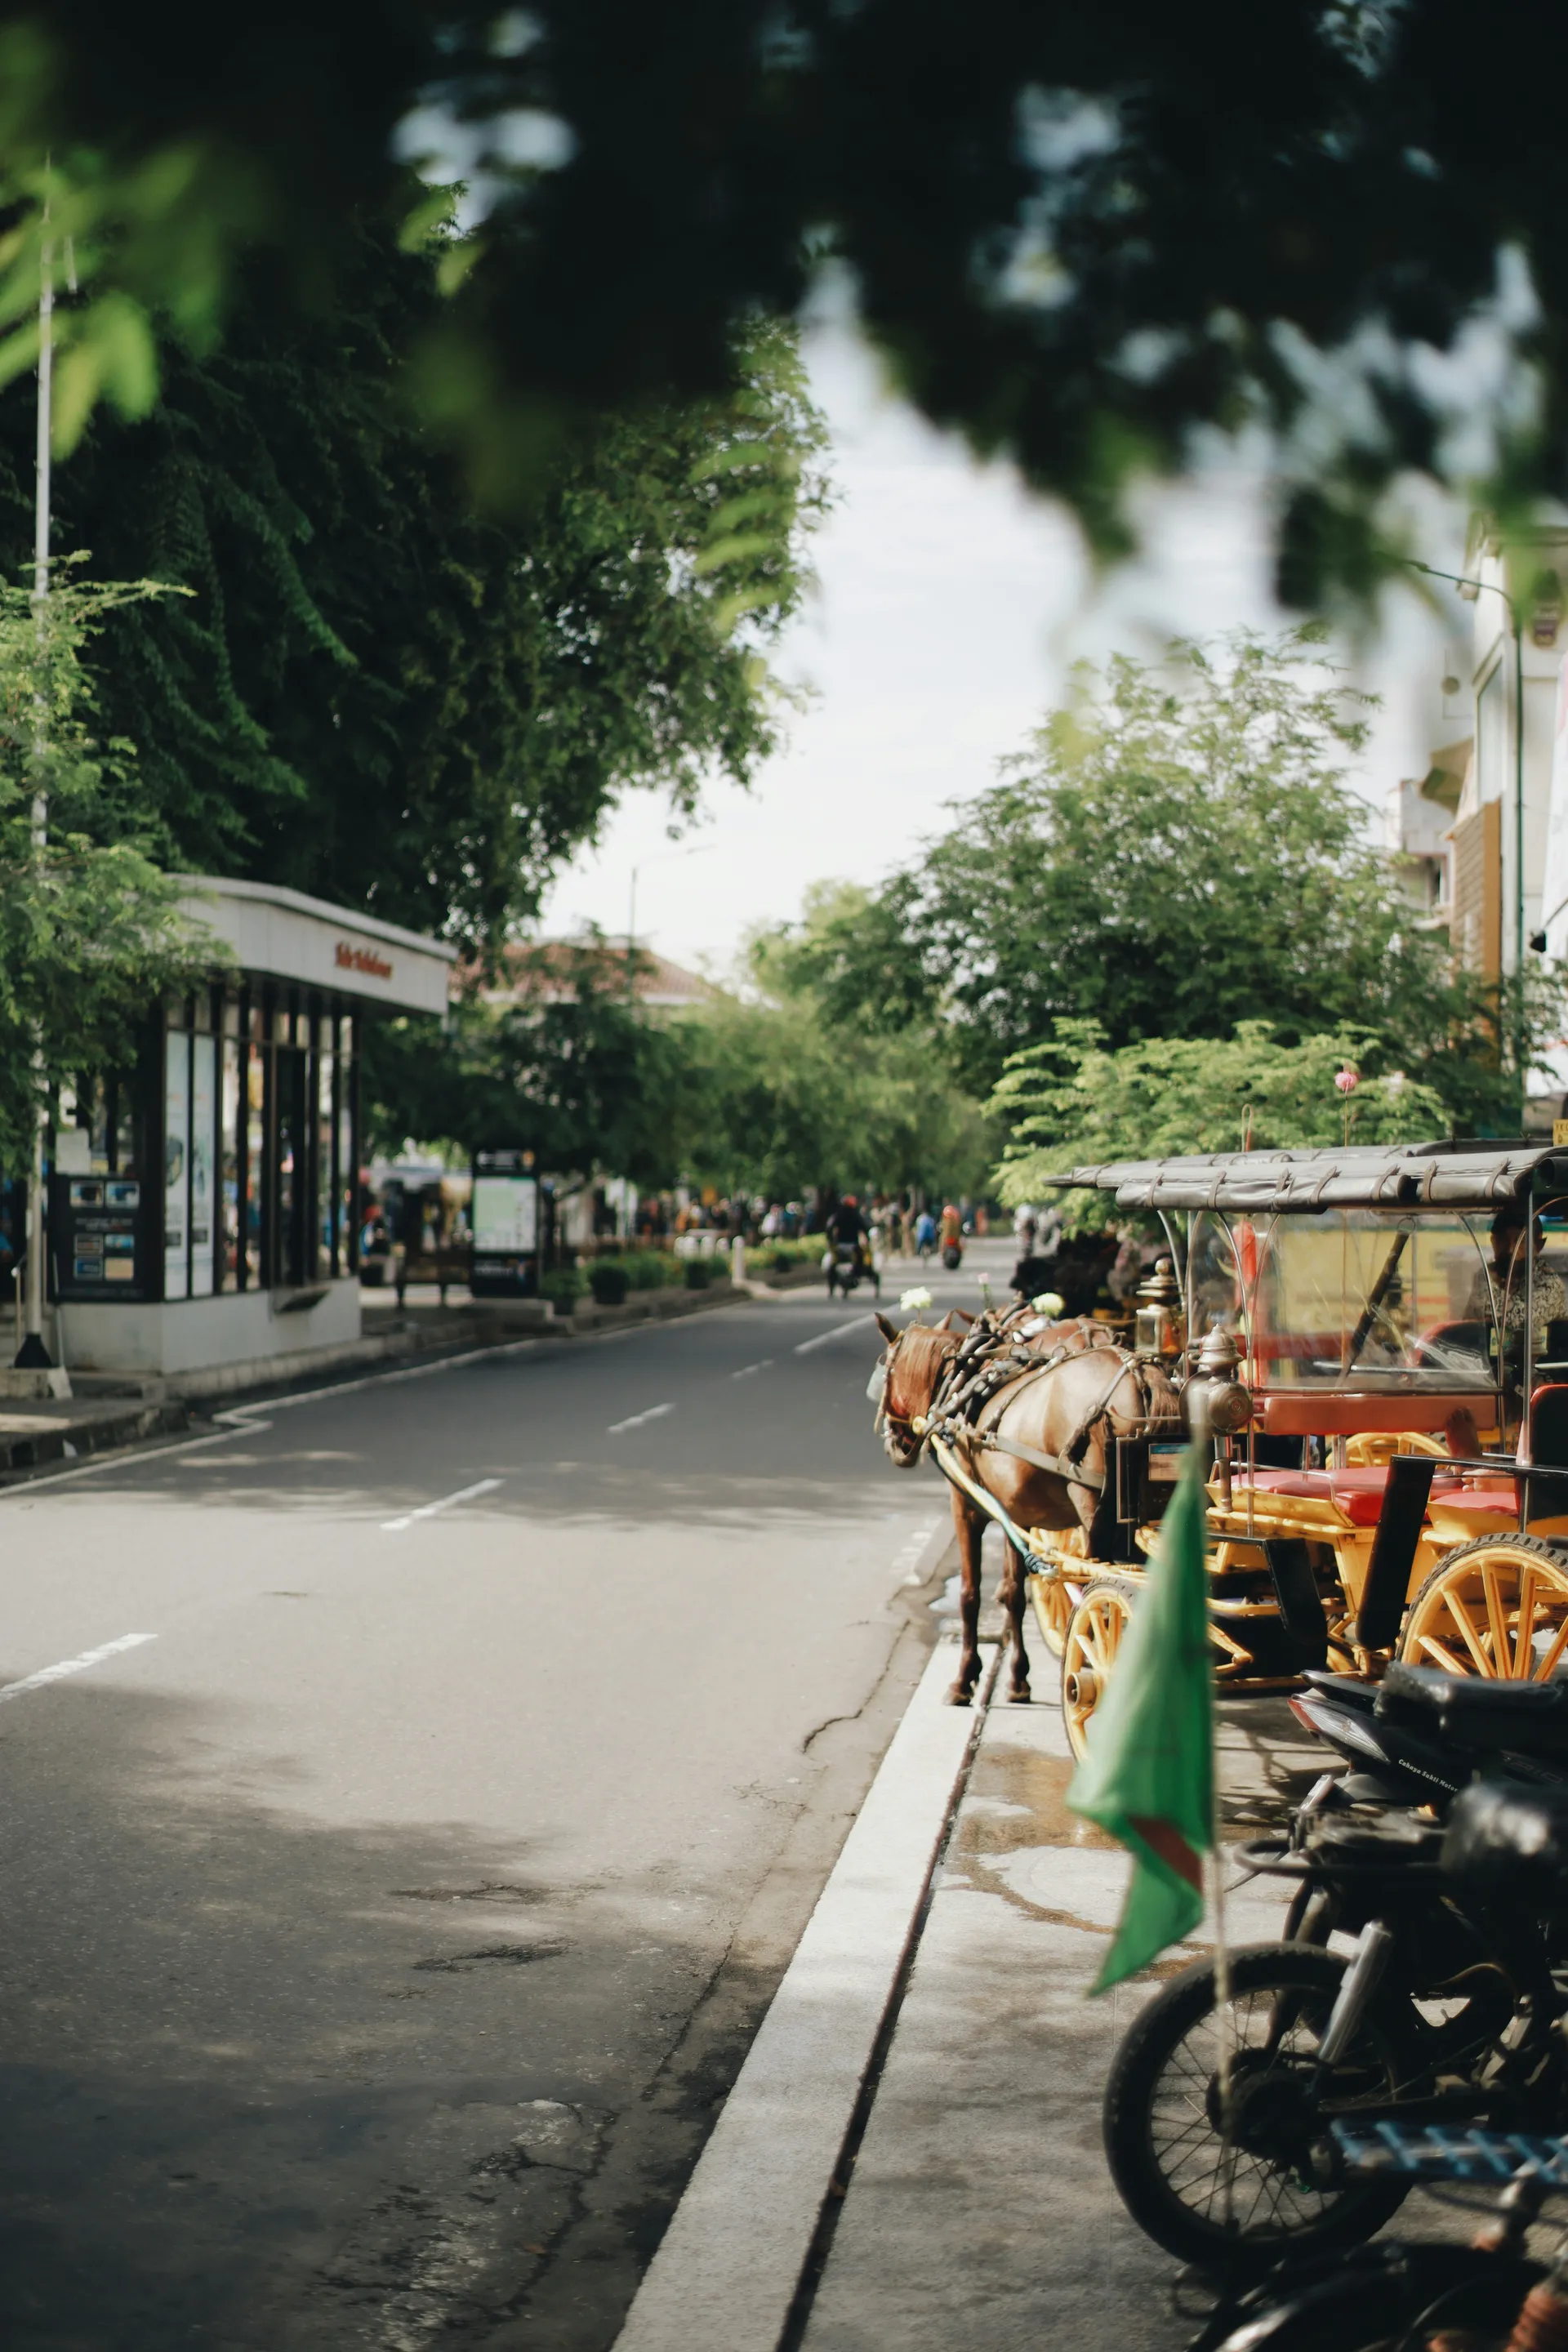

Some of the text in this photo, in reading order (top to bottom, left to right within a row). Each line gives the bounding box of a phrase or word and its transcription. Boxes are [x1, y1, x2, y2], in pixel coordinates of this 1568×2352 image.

[1398, 1758, 1459, 1793] Cahaya Sakti Motor
